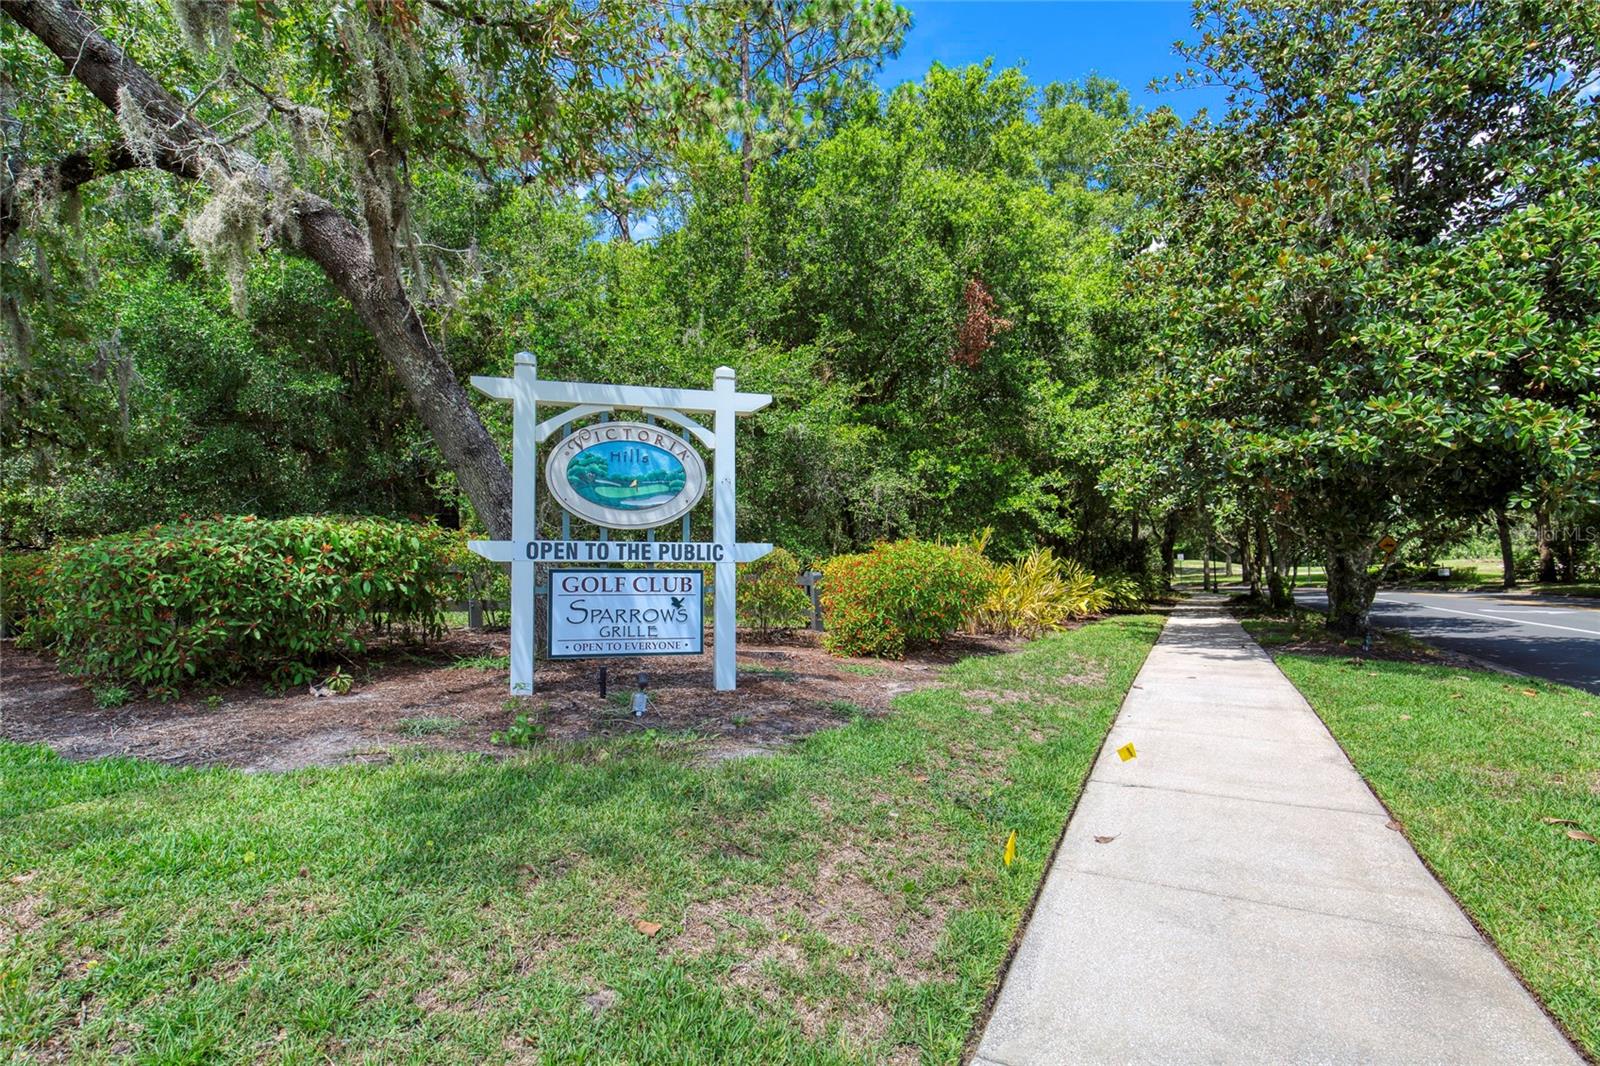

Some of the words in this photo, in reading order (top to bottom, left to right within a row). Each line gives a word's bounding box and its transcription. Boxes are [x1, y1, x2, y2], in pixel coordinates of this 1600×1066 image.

[568, 428, 688, 461] VICTORIA
[610, 448, 649, 464] Hills
[526, 541, 578, 560] OPEN
[585, 543, 609, 560] TO
[616, 543, 651, 561] THE
[659, 543, 724, 561] PUBLIC
[562, 576, 626, 593] GOLF
[632, 576, 693, 593] CLUB
[599, 625, 659, 637] GRILLE
[573, 641, 603, 652] OPEN
[606, 642, 622, 652] TO
[625, 640, 681, 650] EVERYONE
